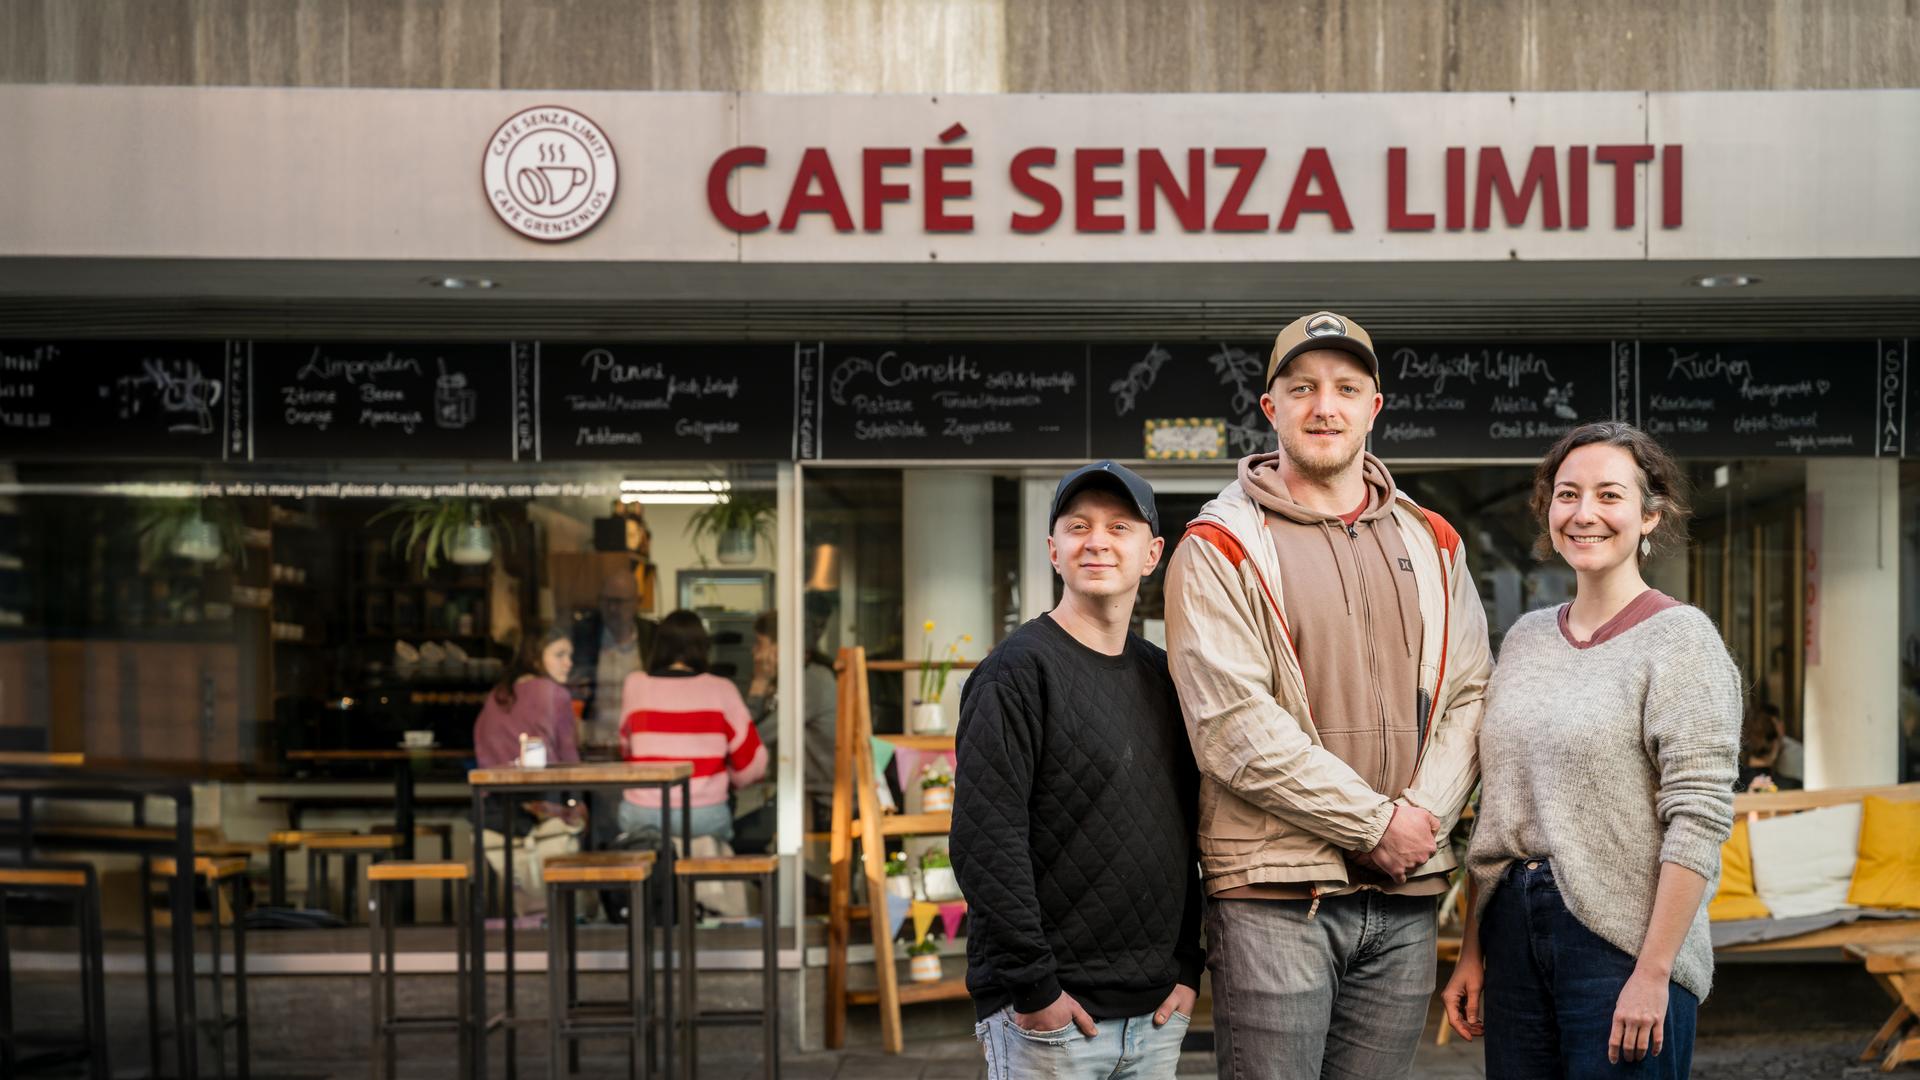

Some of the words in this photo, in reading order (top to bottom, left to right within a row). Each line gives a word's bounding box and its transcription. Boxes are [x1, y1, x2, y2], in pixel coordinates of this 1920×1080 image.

[522, 112, 569, 128] SENZA
[572, 121, 606, 158] LIMITI
[706, 122, 974, 234] CAFÉ
[1009, 146, 1354, 233] SENZA
[1387, 145, 1684, 231] LIMITI
[523, 191, 607, 234] GRENZENLOS
[296, 345, 423, 384] Limonaden
[580, 348, 664, 383] Panini
[875, 350, 982, 387] Cornetti
[1391, 347, 1481, 394] Belgische
[1481, 348, 1557, 388] Waffeln
[1666, 346, 1753, 384] Kuchen
[285, 407, 333, 431] Orange
[226, 482, 251, 497] who
[253, 483, 267, 497] in
[268, 484, 304, 500] many
[306, 482, 339, 497] small
[340, 482, 377, 499] places
[378, 482, 396, 497] do
[397, 484, 432, 499] many
[433, 482, 467, 497] small
[508, 484, 532, 497] can
